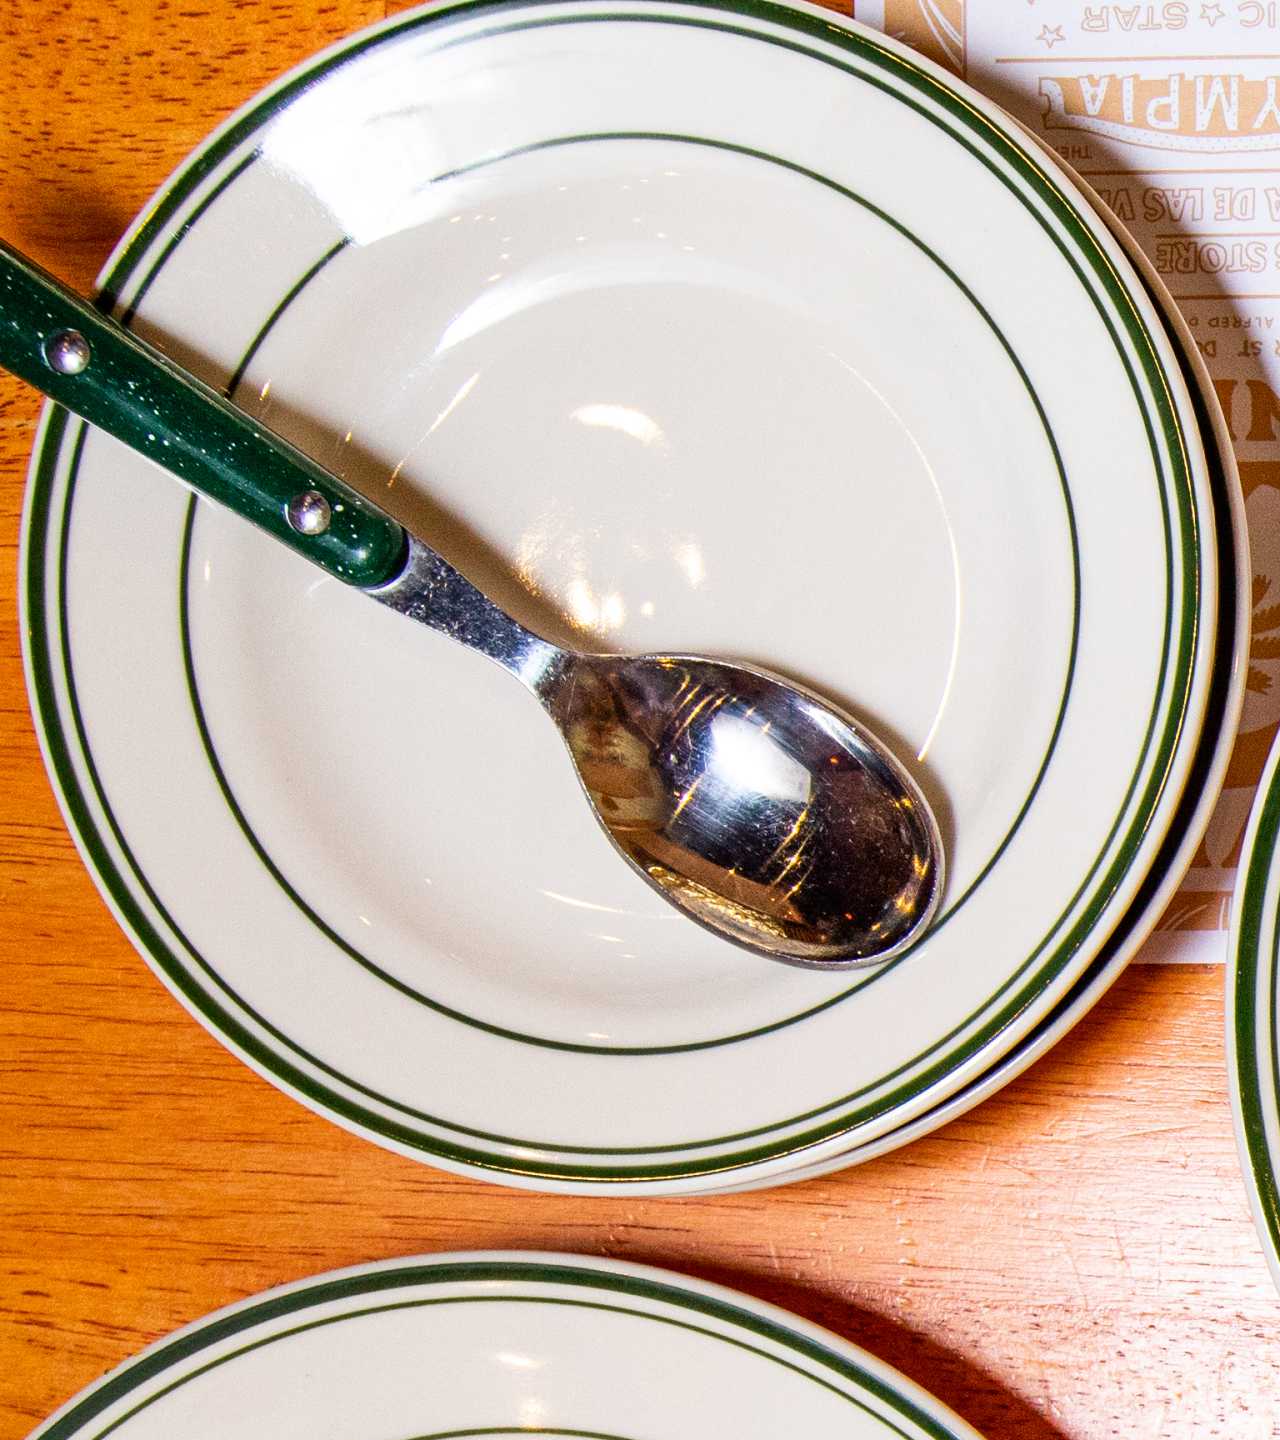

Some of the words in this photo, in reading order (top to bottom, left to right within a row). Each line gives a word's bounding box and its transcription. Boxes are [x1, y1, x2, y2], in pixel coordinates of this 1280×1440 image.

[1080, 3, 1190, 32] STAR
[1140, 188, 1203, 223] LAS
[1214, 188, 1255, 222] DE
[1155, 243, 1268, 274] STORE
[1208, 314, 1274, 329] ALFRED
[1235, 339, 1263, 358] ST
